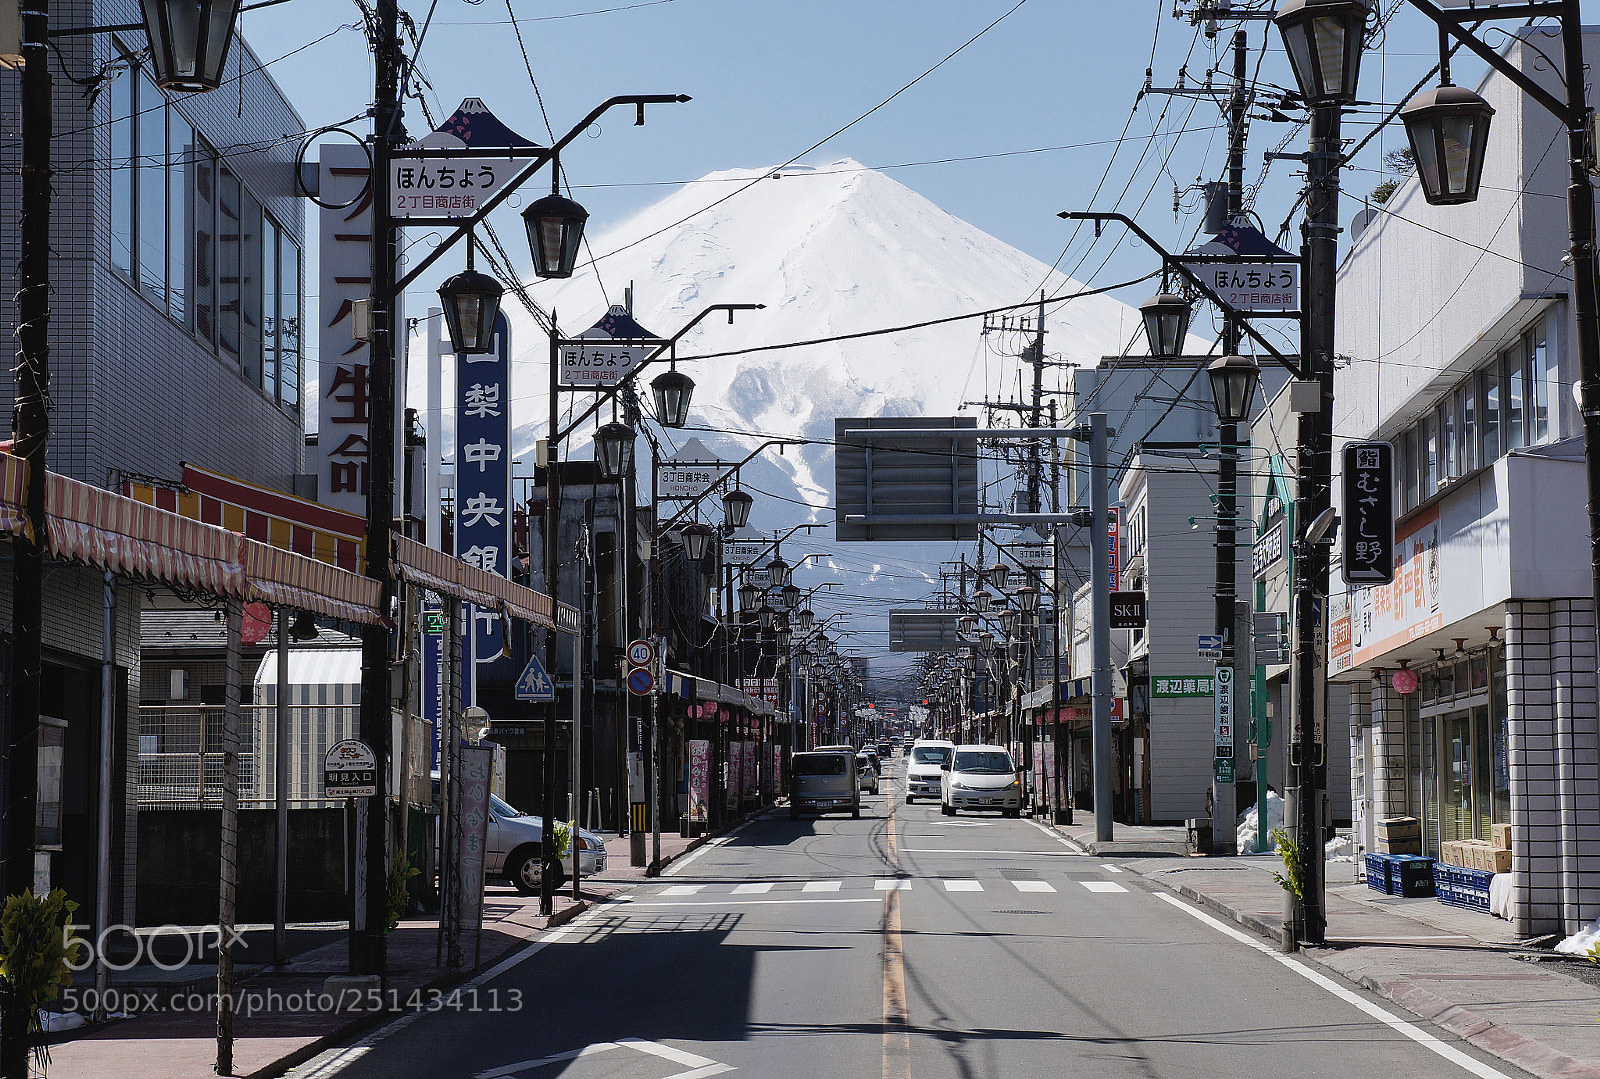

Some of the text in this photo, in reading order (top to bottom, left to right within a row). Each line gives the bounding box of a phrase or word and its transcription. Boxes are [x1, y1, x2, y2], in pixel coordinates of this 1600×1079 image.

[396, 164, 496, 190] ほんちょう
[396, 194, 475, 210] 2丁目商店街
[1214, 269, 1293, 289] ほんちょう
[1230, 292, 1293, 304] 2丁目商店街
[564, 350, 632, 367] ほんちょう
[564, 370, 618, 381] 2丁目商店街
[1358, 449, 1380, 468] 鮨
[662, 471, 710, 484] 3丁目商栄会
[1355, 471, 1382, 564] むさし野
[1114, 604, 1140, 617] SK-II
[633, 647, 648, 660] 40
[328, 772, 372, 783] 明見入口
